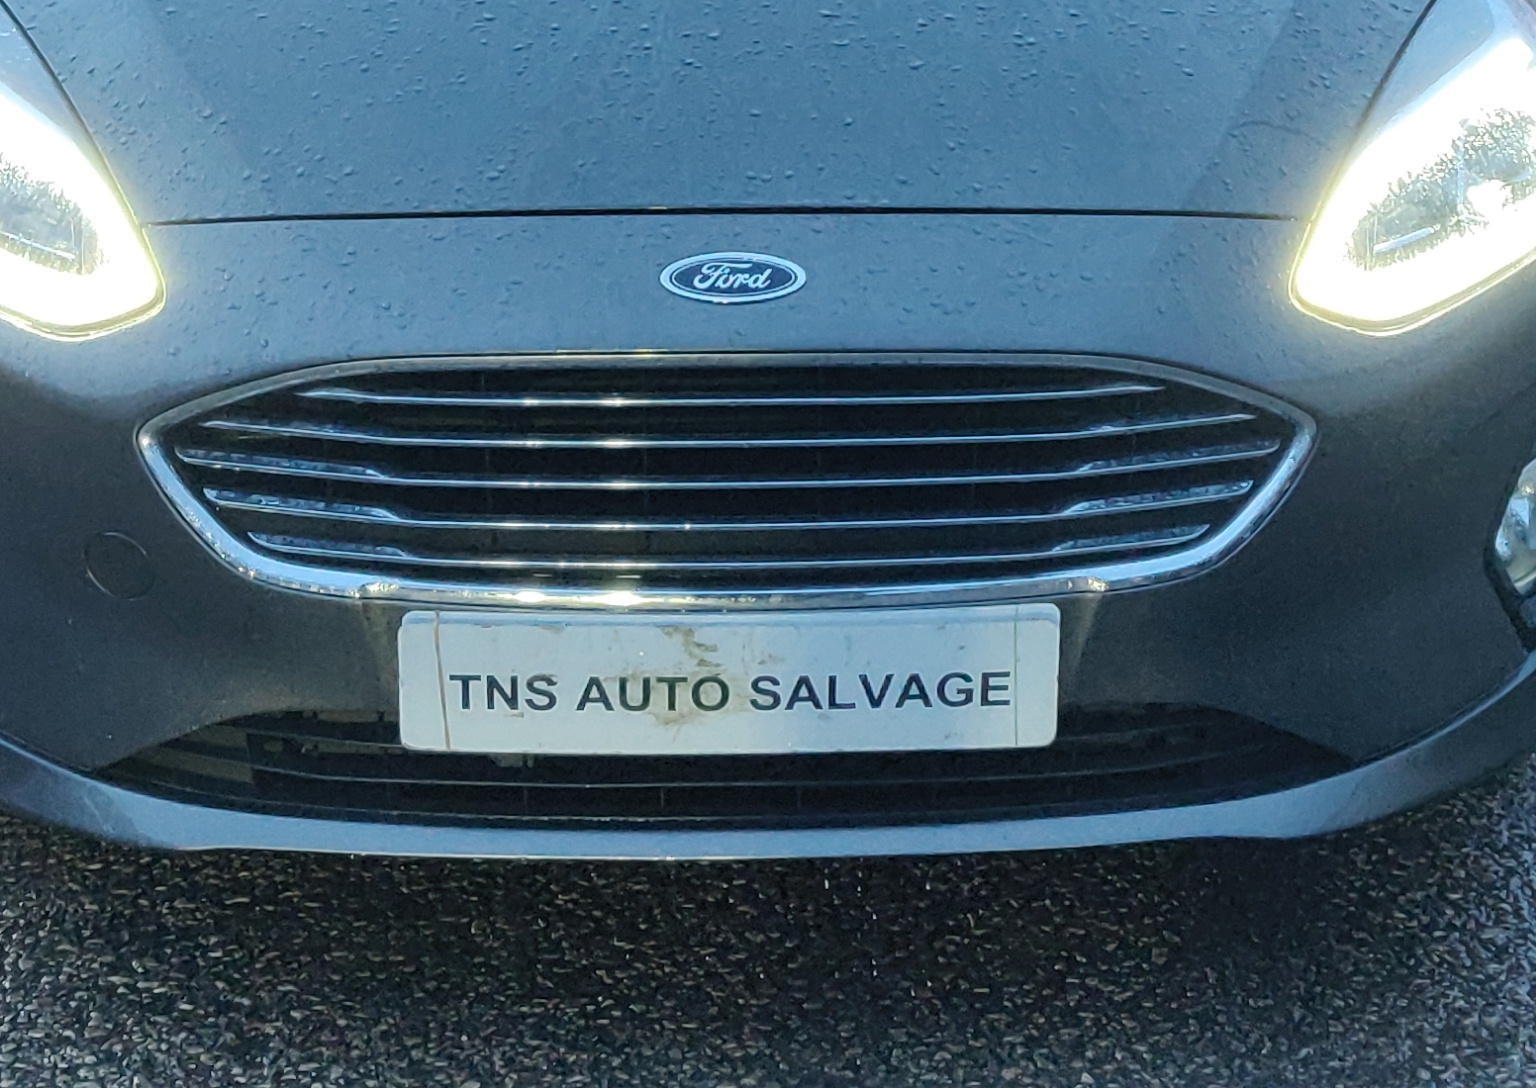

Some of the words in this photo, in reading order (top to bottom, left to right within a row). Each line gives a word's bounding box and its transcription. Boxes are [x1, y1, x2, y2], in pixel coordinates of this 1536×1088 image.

[692, 262, 773, 289] Ford
[448, 673, 559, 712] TNS
[575, 672, 731, 713] AUTO
[749, 671, 1012, 712] SALVAGE
